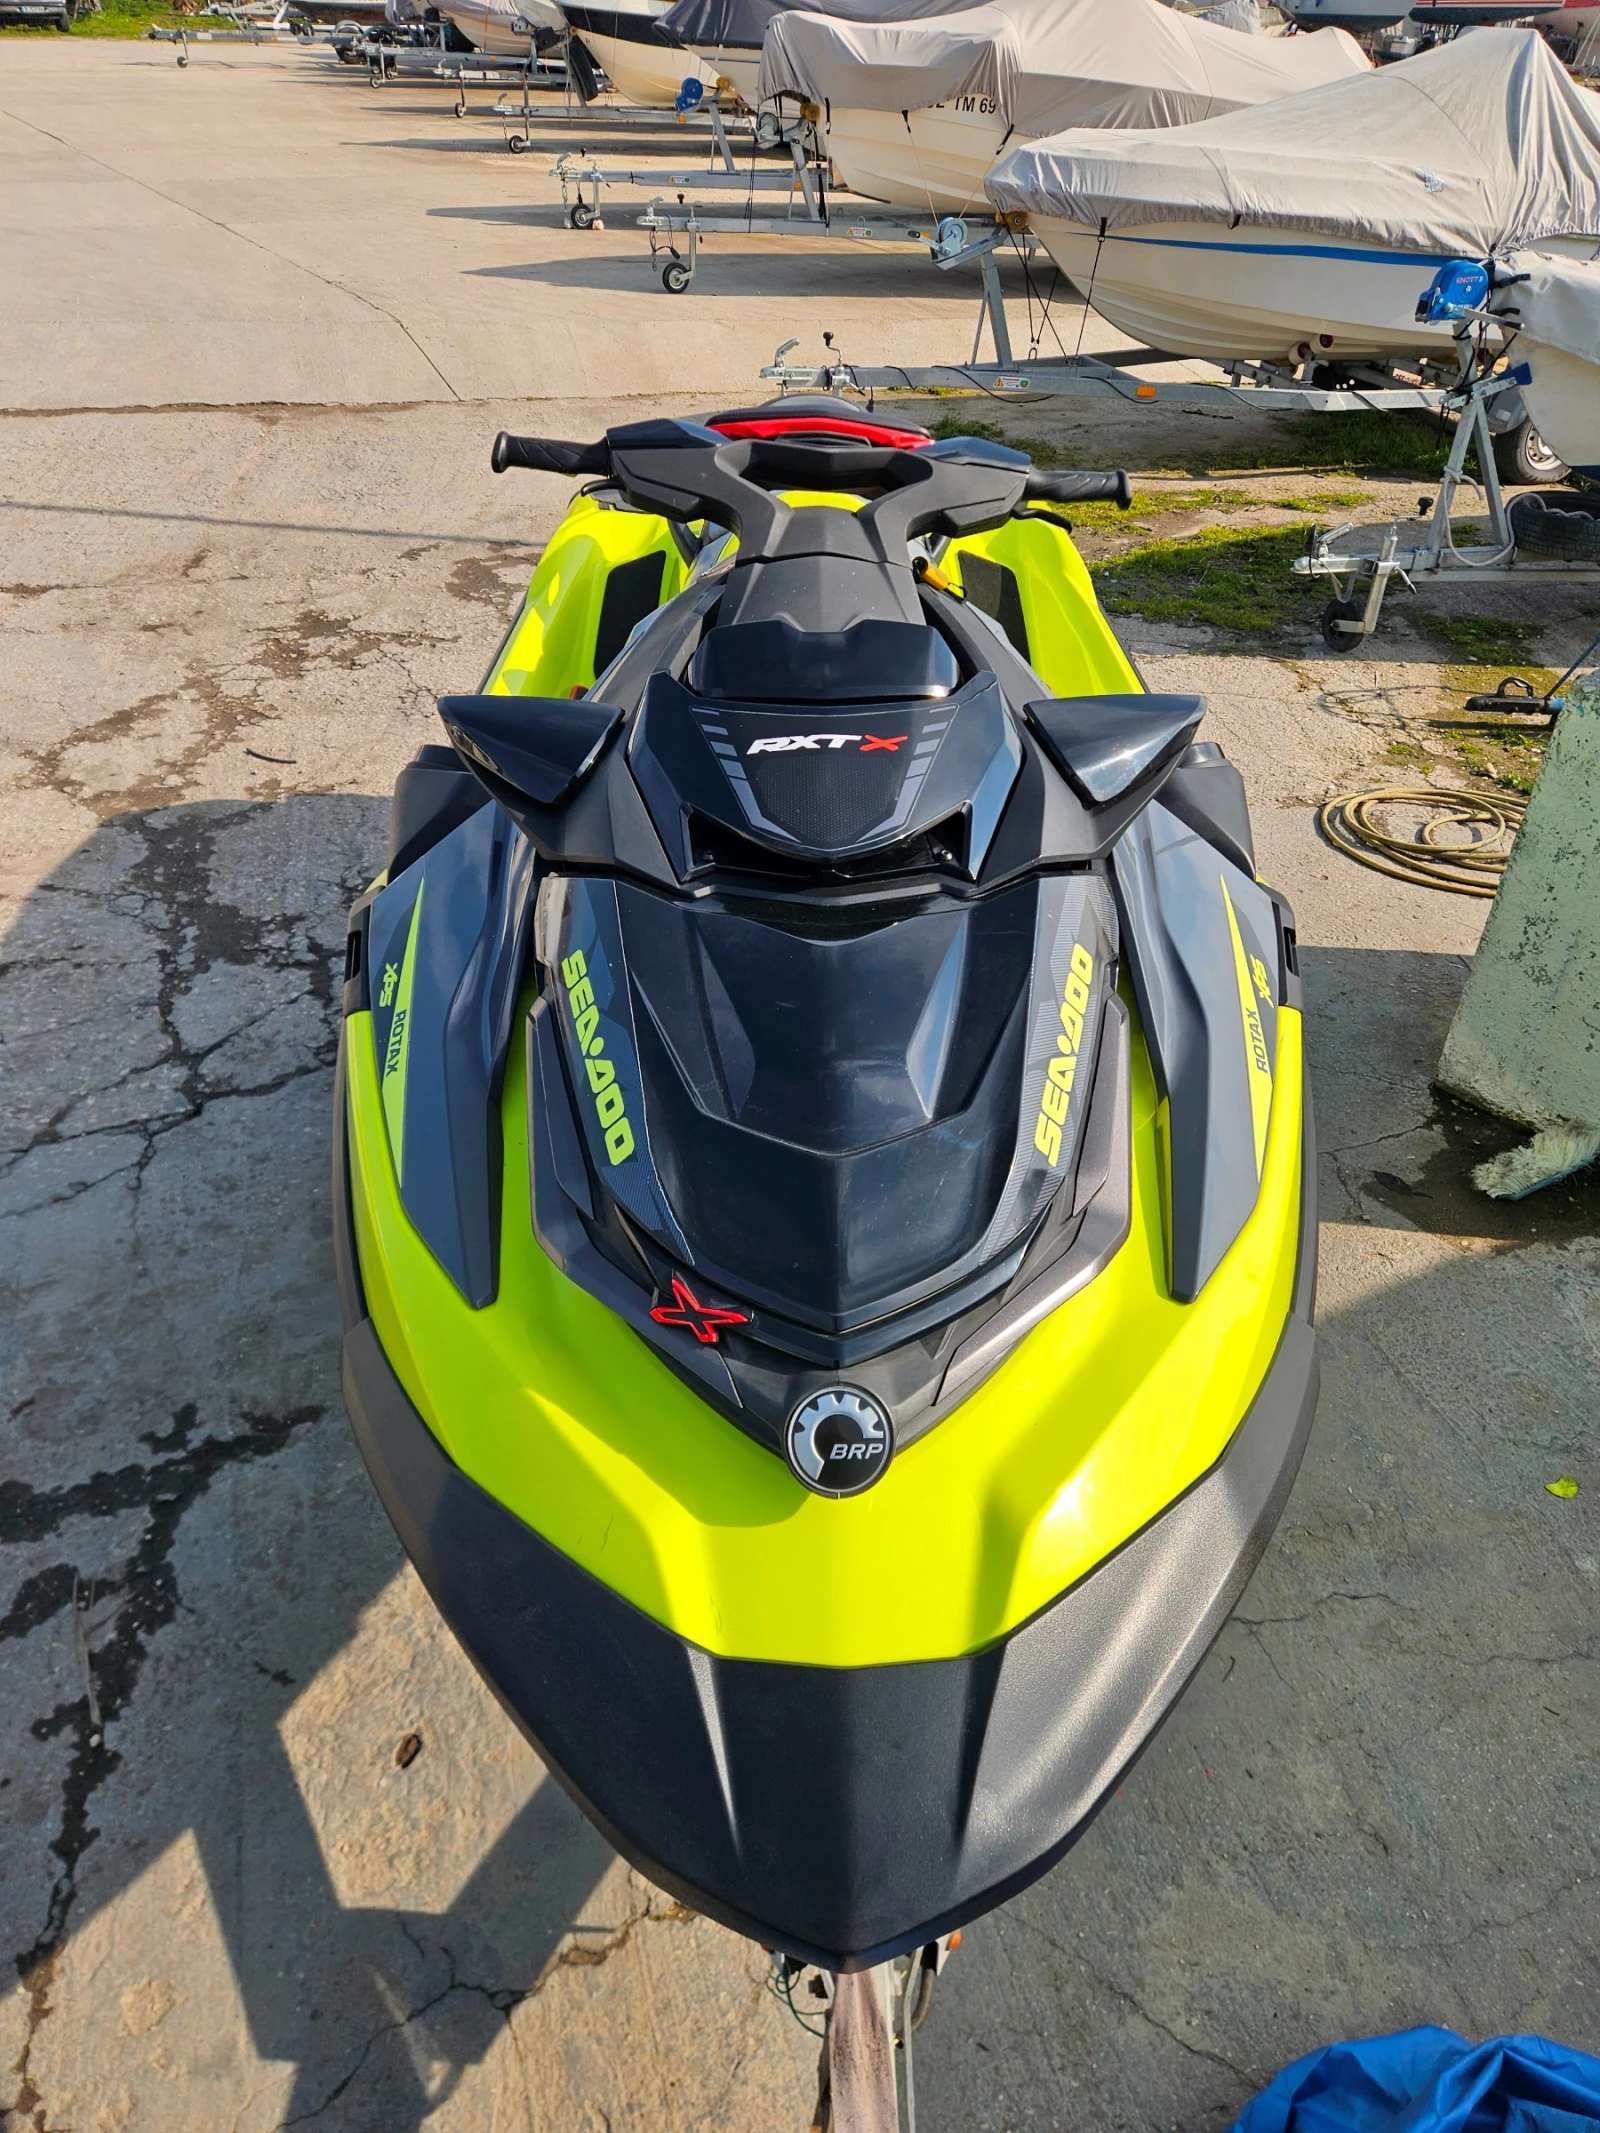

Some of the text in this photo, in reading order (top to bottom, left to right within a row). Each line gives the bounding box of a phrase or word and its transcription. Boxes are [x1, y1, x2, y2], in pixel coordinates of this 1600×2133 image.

[955, 96, 976, 112] TM
[979, 98, 996, 114] 69
[385, 1008, 407, 1078] ROTAX
[1245, 1007, 1269, 1074] ROTAX
[829, 1443, 884, 1461] BRP
